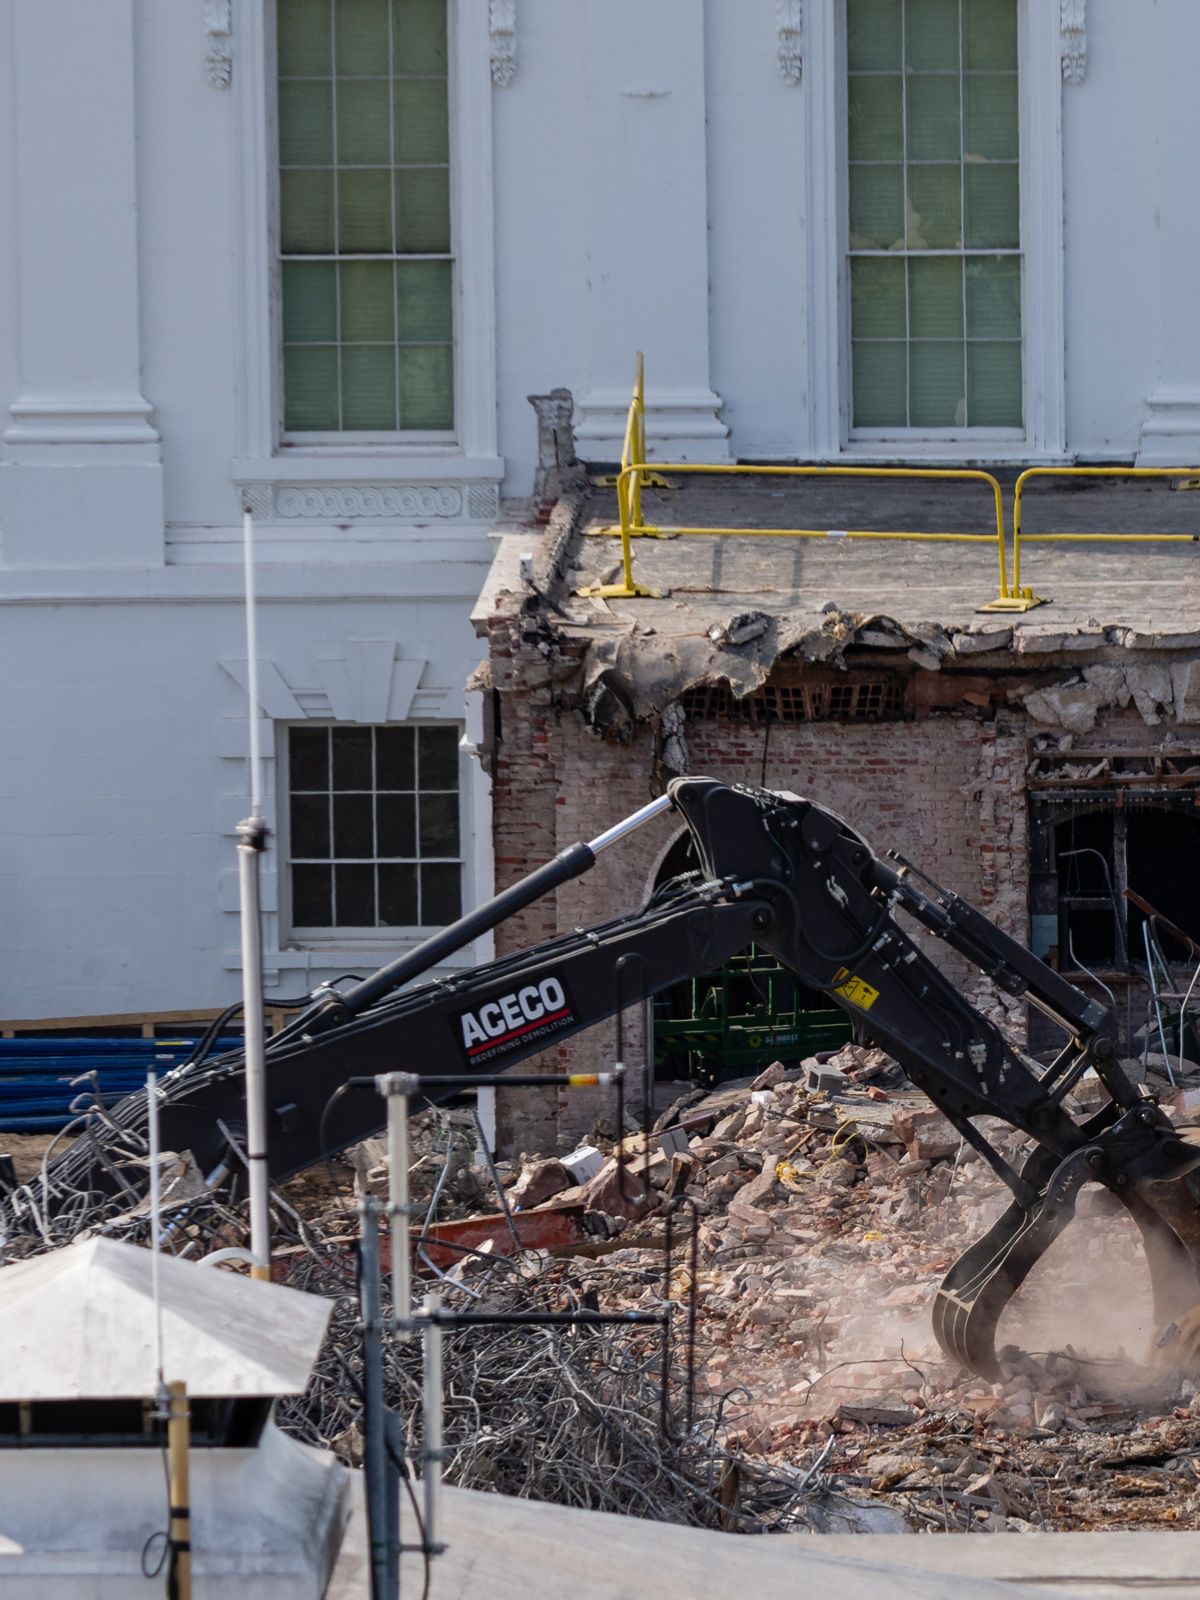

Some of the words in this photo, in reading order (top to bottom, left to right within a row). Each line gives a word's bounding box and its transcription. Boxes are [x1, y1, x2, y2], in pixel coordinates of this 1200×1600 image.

[461, 977, 565, 1048] ACECO
[470, 1038, 521, 1064] REDEFINING
[522, 1016, 574, 1042] DEMOLITION
